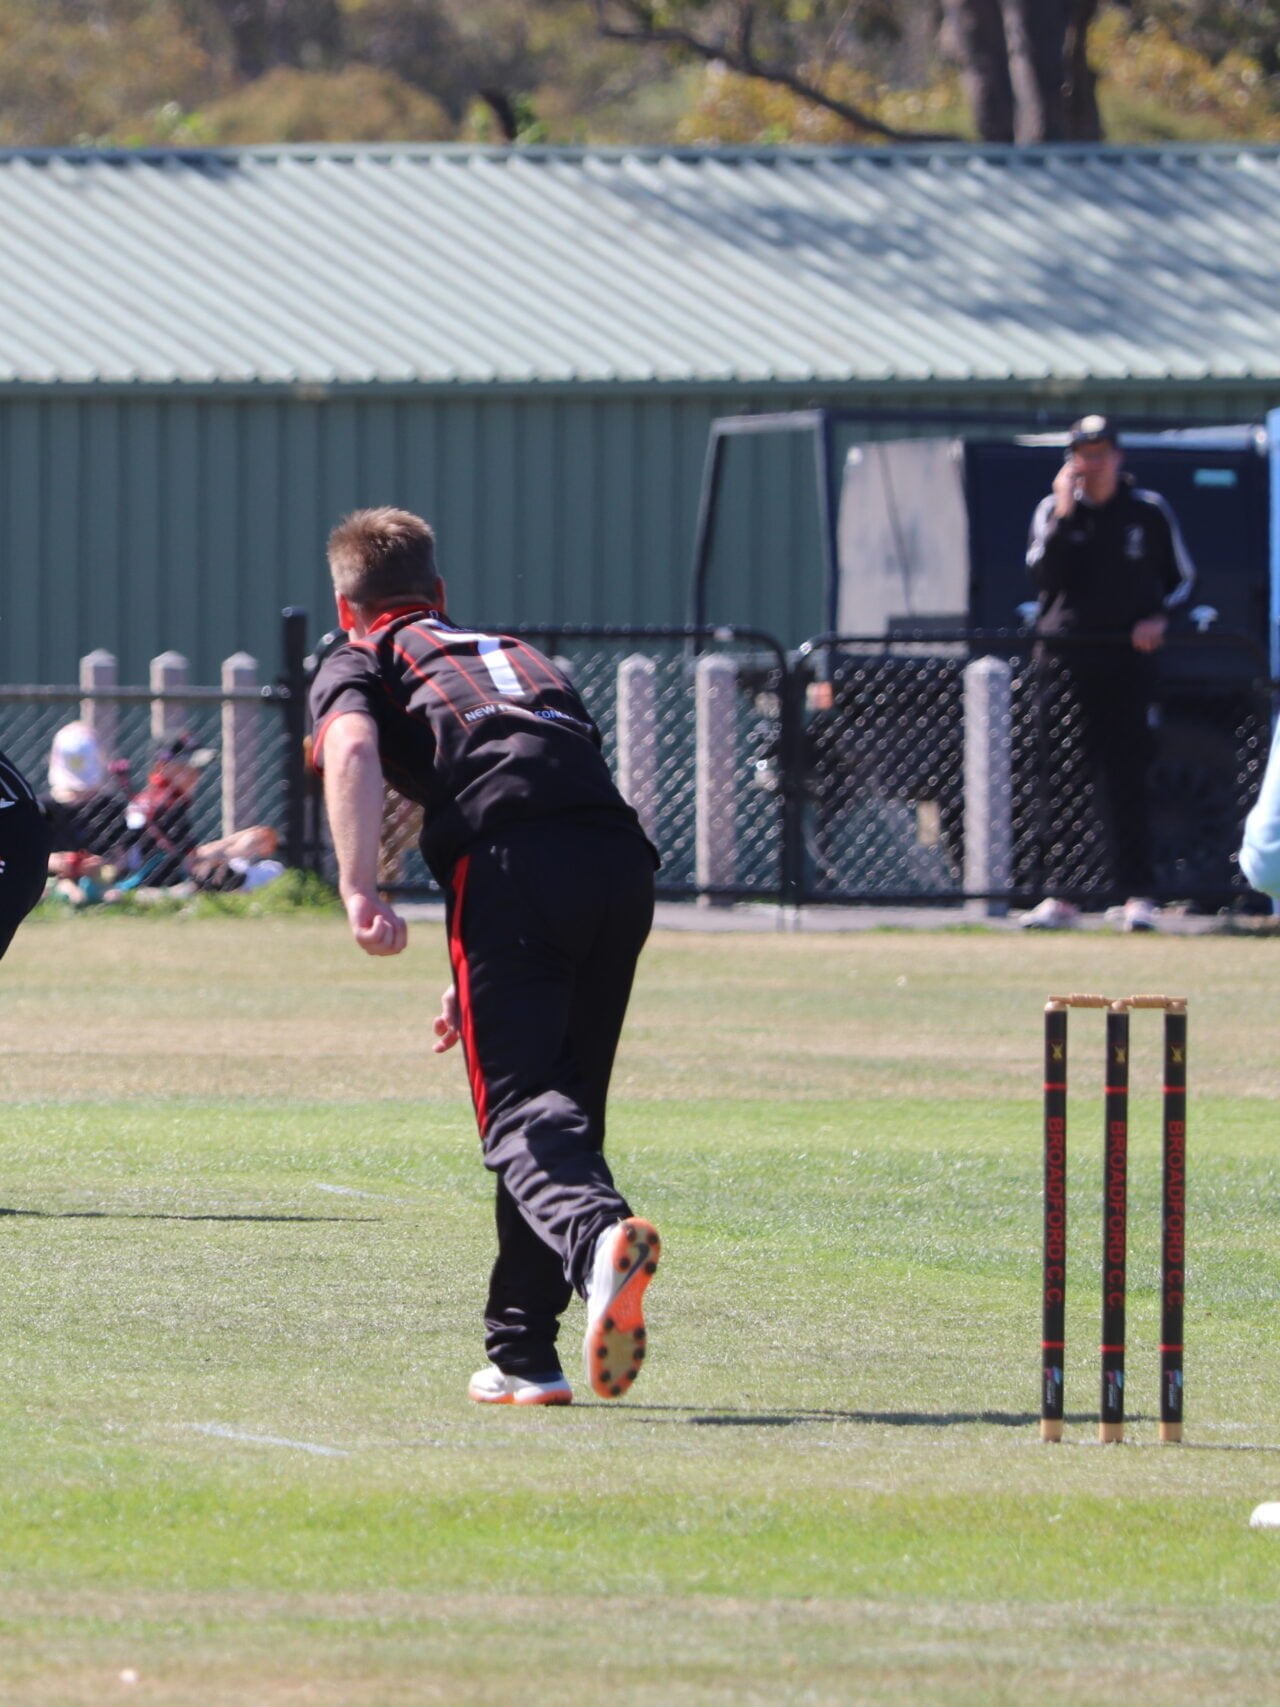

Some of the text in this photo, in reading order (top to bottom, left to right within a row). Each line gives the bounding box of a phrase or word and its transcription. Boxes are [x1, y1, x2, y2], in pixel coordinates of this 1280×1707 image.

[464, 704, 496, 722] NEW
[1047, 1116, 1064, 1259] BROADFORD
[1108, 1120, 1125, 1263] BROADFORD
[1167, 1120, 1184, 1263] BROADFORD
